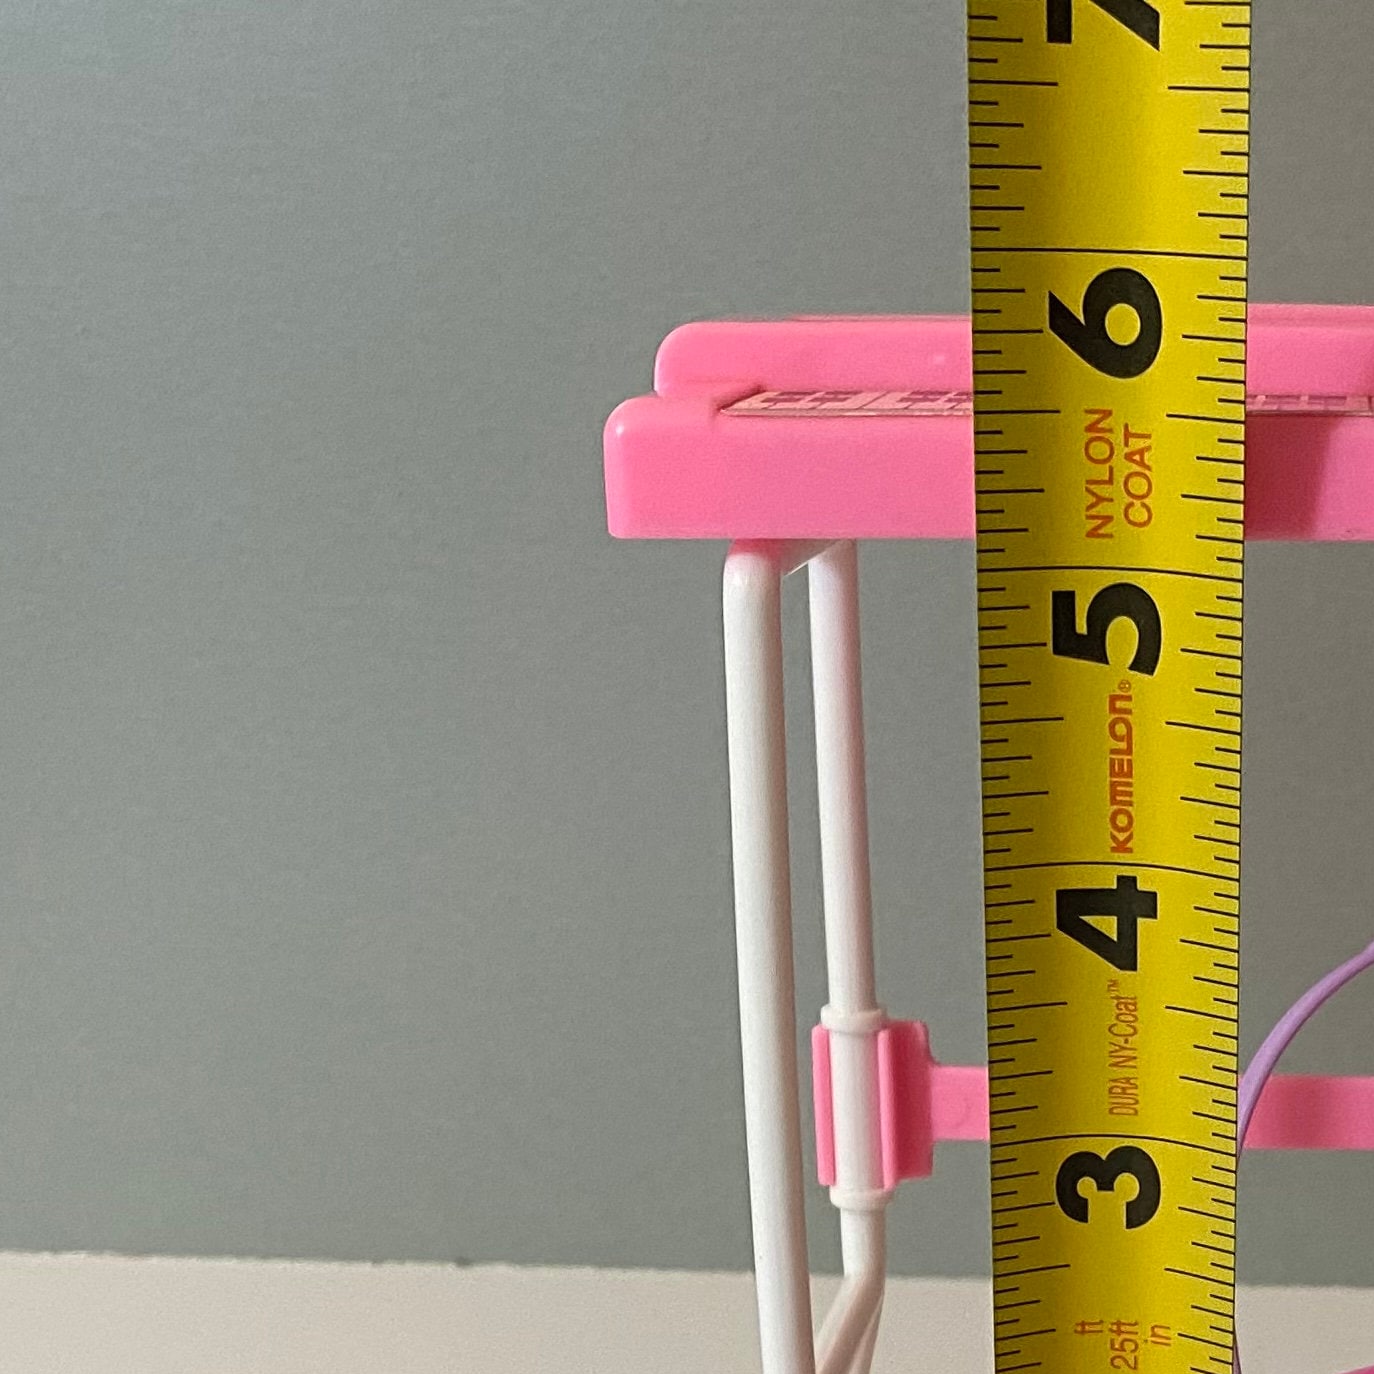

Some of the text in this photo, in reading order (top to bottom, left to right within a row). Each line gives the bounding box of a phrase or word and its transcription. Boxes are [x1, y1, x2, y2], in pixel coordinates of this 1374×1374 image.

[1048, 267, 1162, 378] 6
[1084, 408, 1115, 539] NYLON
[1123, 422, 1153, 528] COAT
[1051, 582, 1162, 676] 5
[1056, 874, 1158, 972] 4
[1109, 1077, 1138, 1117] DURA
[1055, 1145, 1161, 1229] 3
